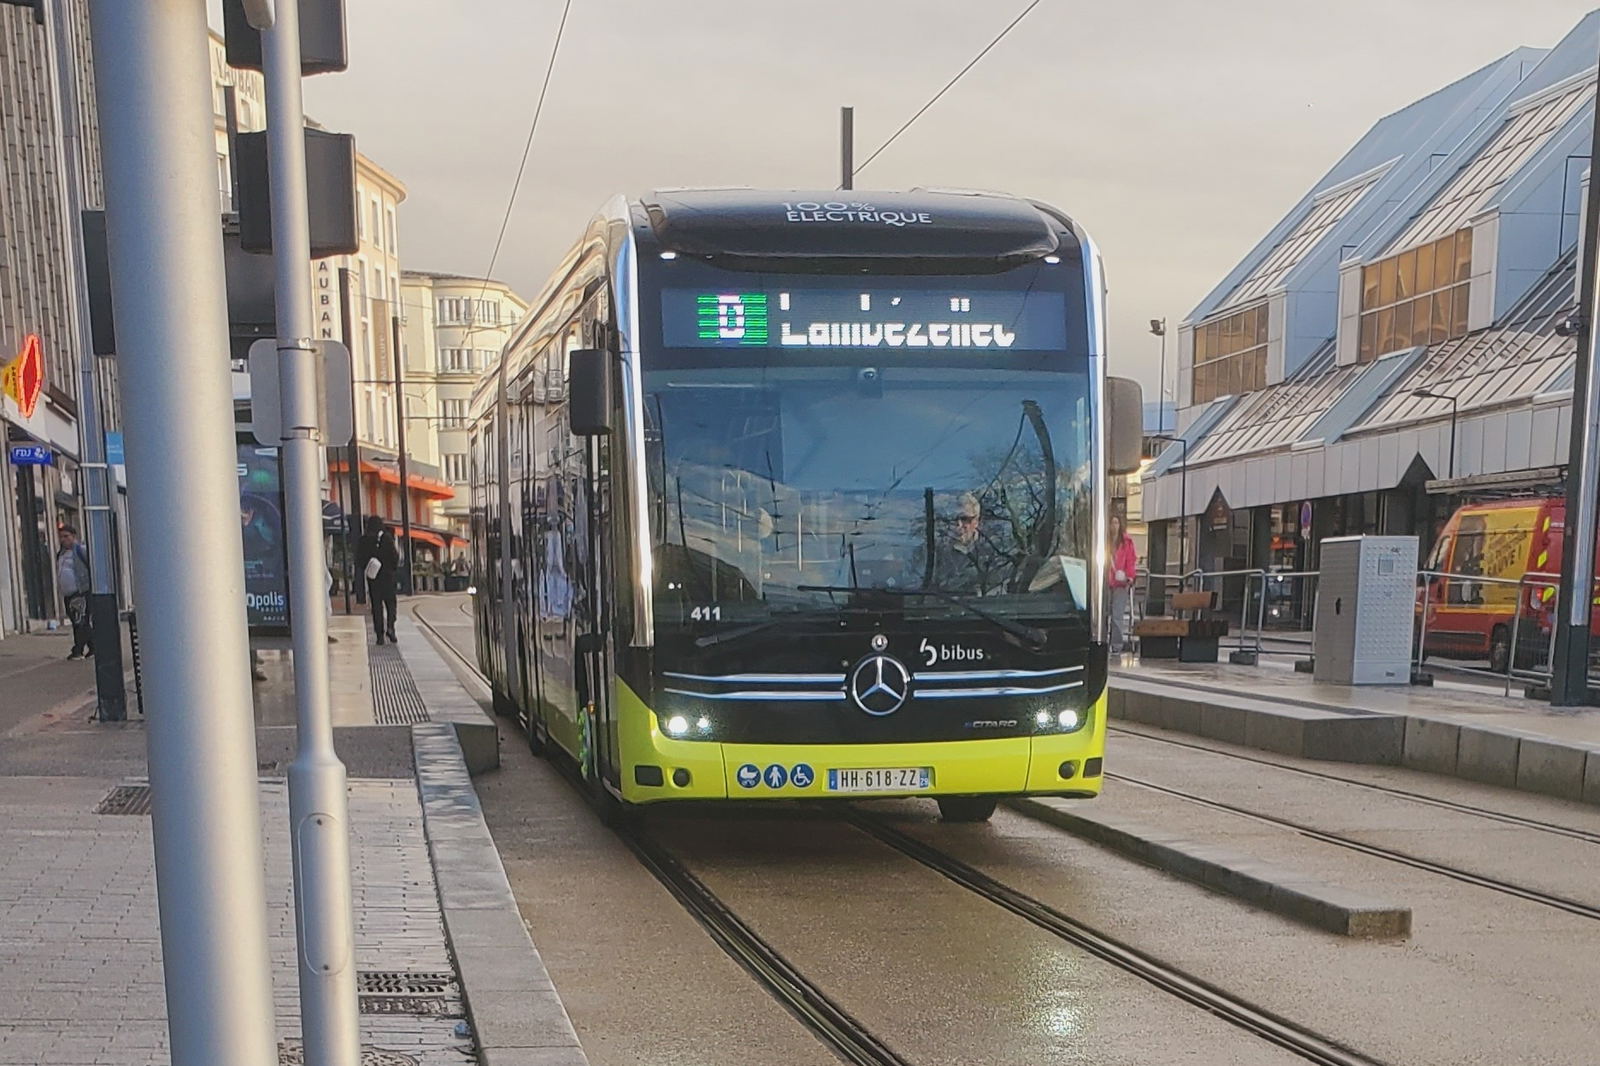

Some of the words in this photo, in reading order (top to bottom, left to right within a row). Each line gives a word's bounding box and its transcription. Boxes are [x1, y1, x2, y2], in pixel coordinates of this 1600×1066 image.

[783, 202, 876, 212] 100%
[786, 210, 933, 227] ÉLECTRIQUE
[718, 295, 746, 339] D
[14, 448, 32, 457] FDJ
[690, 606, 721, 621] 411
[941, 644, 984, 660] bibus
[841, 769, 917, 788] HH-618-ZZ
